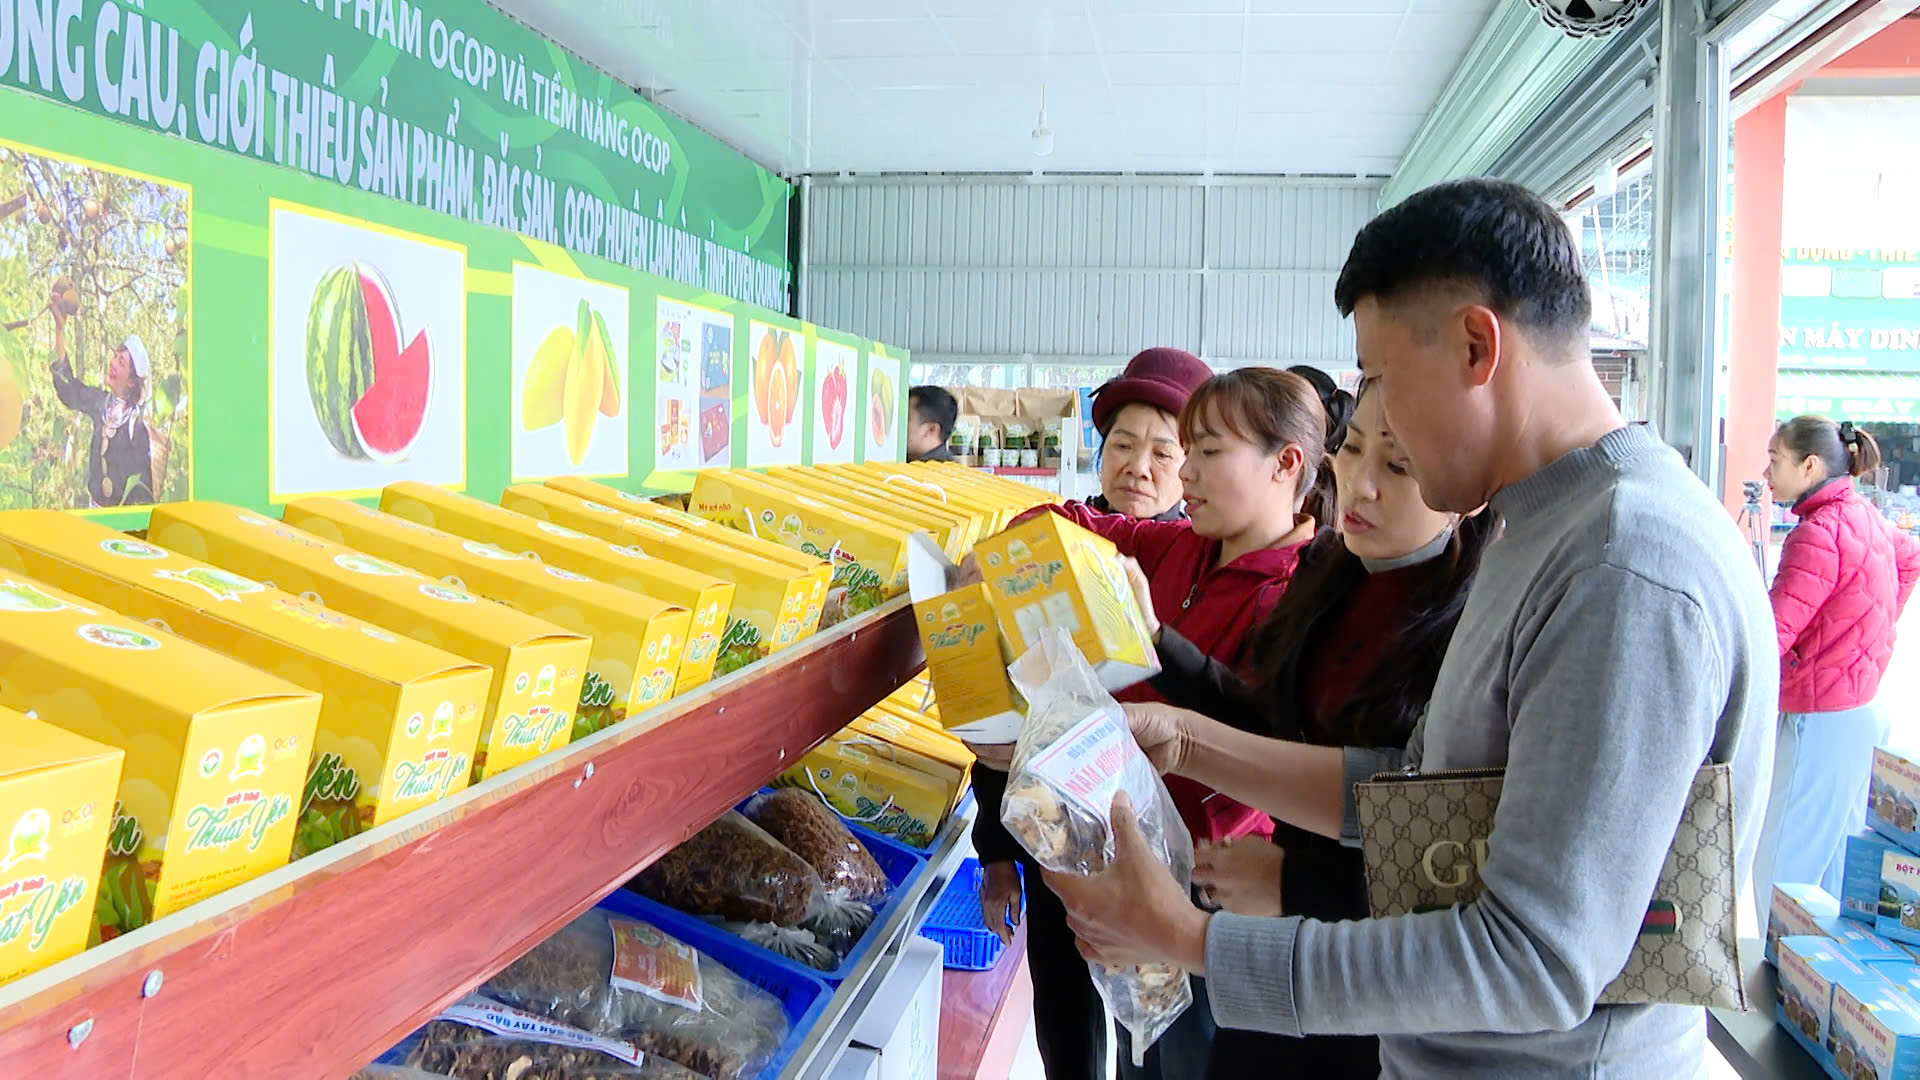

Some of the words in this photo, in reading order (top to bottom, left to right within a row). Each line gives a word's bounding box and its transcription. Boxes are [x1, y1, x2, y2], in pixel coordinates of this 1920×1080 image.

[195, 11, 265, 157] GIỚI
[358, 76, 408, 200] SẢN
[564, 186, 604, 257] OCOP
[649, 199, 674, 280] LÂM
[704, 219, 727, 297] TỈNH
[727, 234, 755, 303] TUYÊN
[429, 18, 497, 92] OCOP
[501, 53, 528, 110] VÀ
[581, 96, 628, 158] NĂNG
[631, 125, 670, 176] OCOP
[1803, 321, 1864, 349] MÁY
[1870, 328, 1920, 351] DIN
